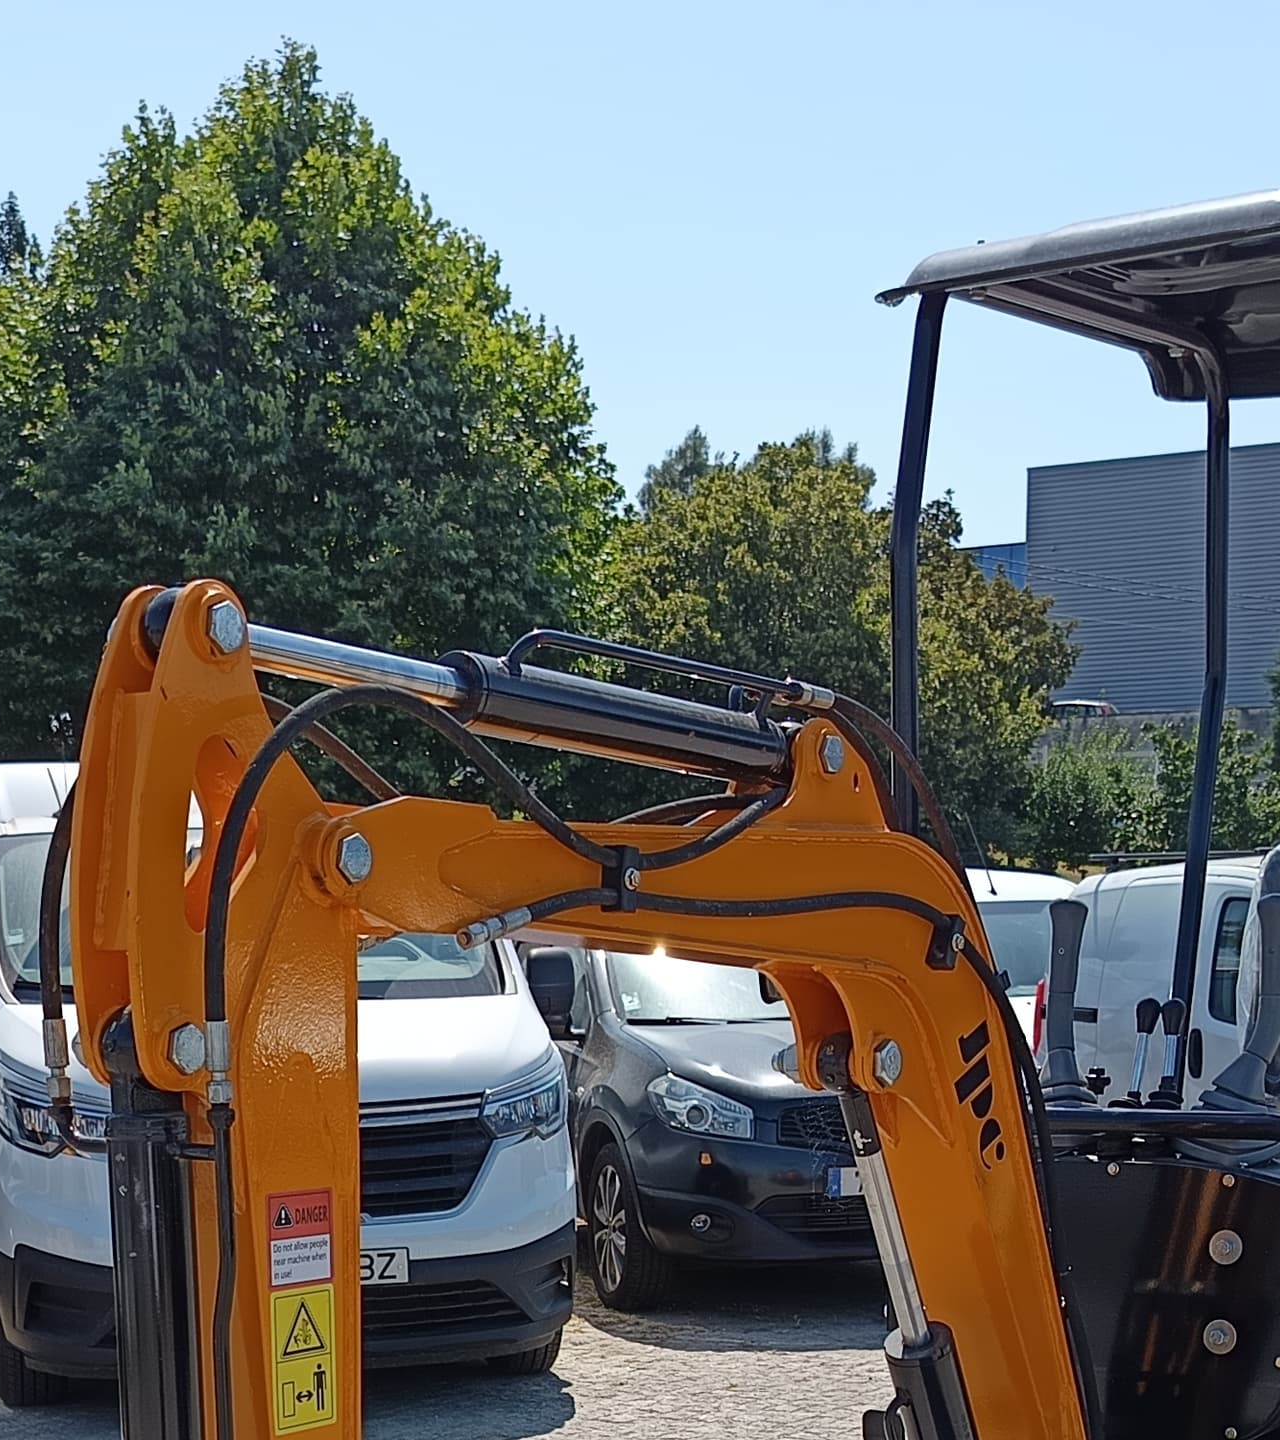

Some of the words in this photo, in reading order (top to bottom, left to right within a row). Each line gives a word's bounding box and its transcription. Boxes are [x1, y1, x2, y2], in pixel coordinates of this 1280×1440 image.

[294, 1205, 328, 1225] DANGER
[273, 1243, 282, 1253] Do
[283, 1243, 293, 1252] not
[294, 1241, 308, 1251] allow
[309, 1238, 328, 1251] people
[273, 1258, 286, 1266] near
[287, 1255, 310, 1264] machine
[311, 1252, 327, 1261] when
[274, 1272, 280, 1280] in
